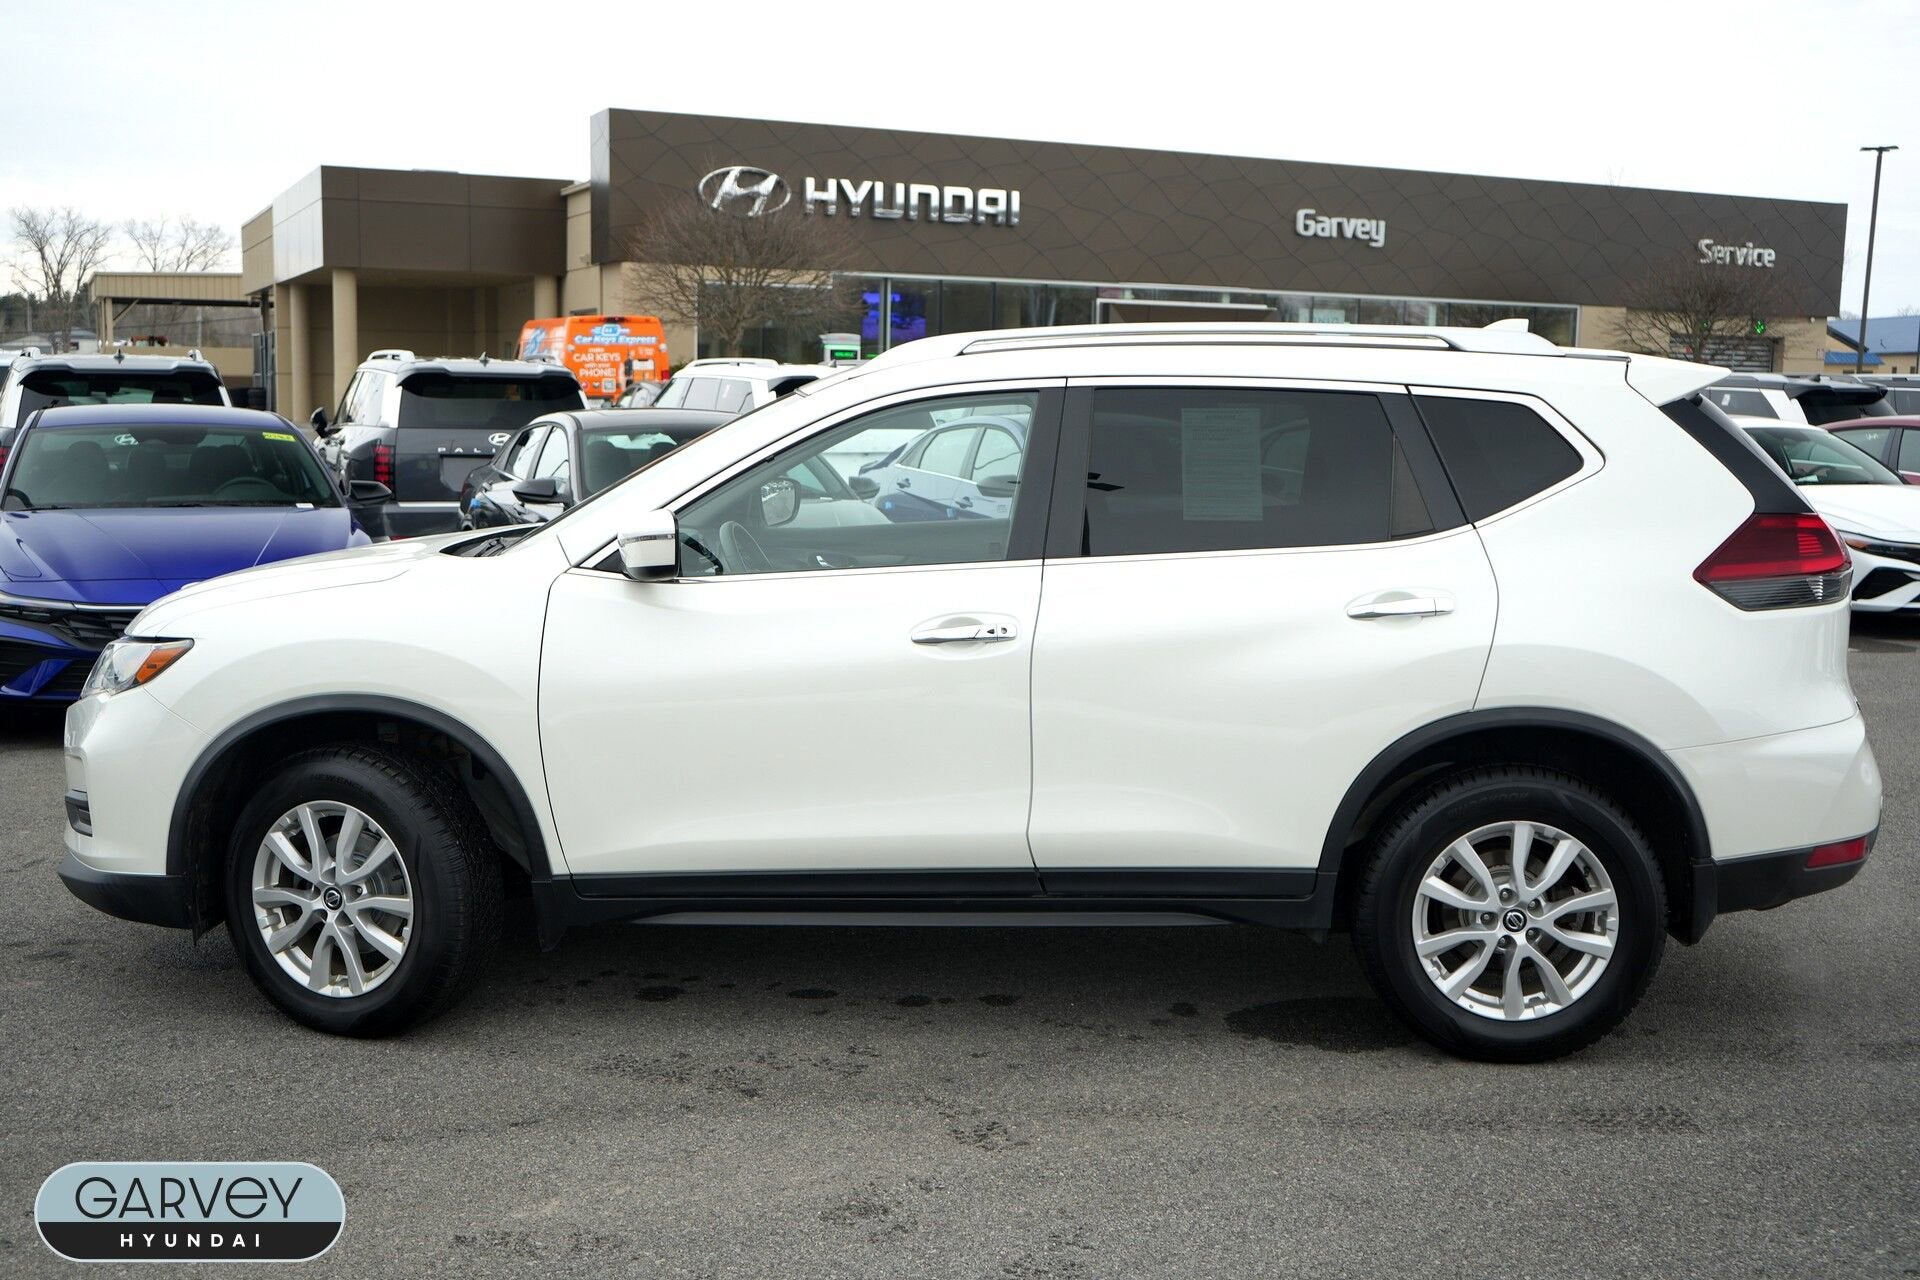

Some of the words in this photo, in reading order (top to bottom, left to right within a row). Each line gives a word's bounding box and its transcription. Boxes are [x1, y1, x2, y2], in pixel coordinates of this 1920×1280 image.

[805, 176, 1020, 226] HYUNDAI
[1296, 208, 1386, 248] Garvey
[1698, 238, 1776, 267] Service
[574, 335, 592, 344] Car
[592, 335, 617, 345] Keys
[618, 336, 657, 345] Express
[573, 353, 594, 362] CAR
[596, 353, 621, 362] KEYS
